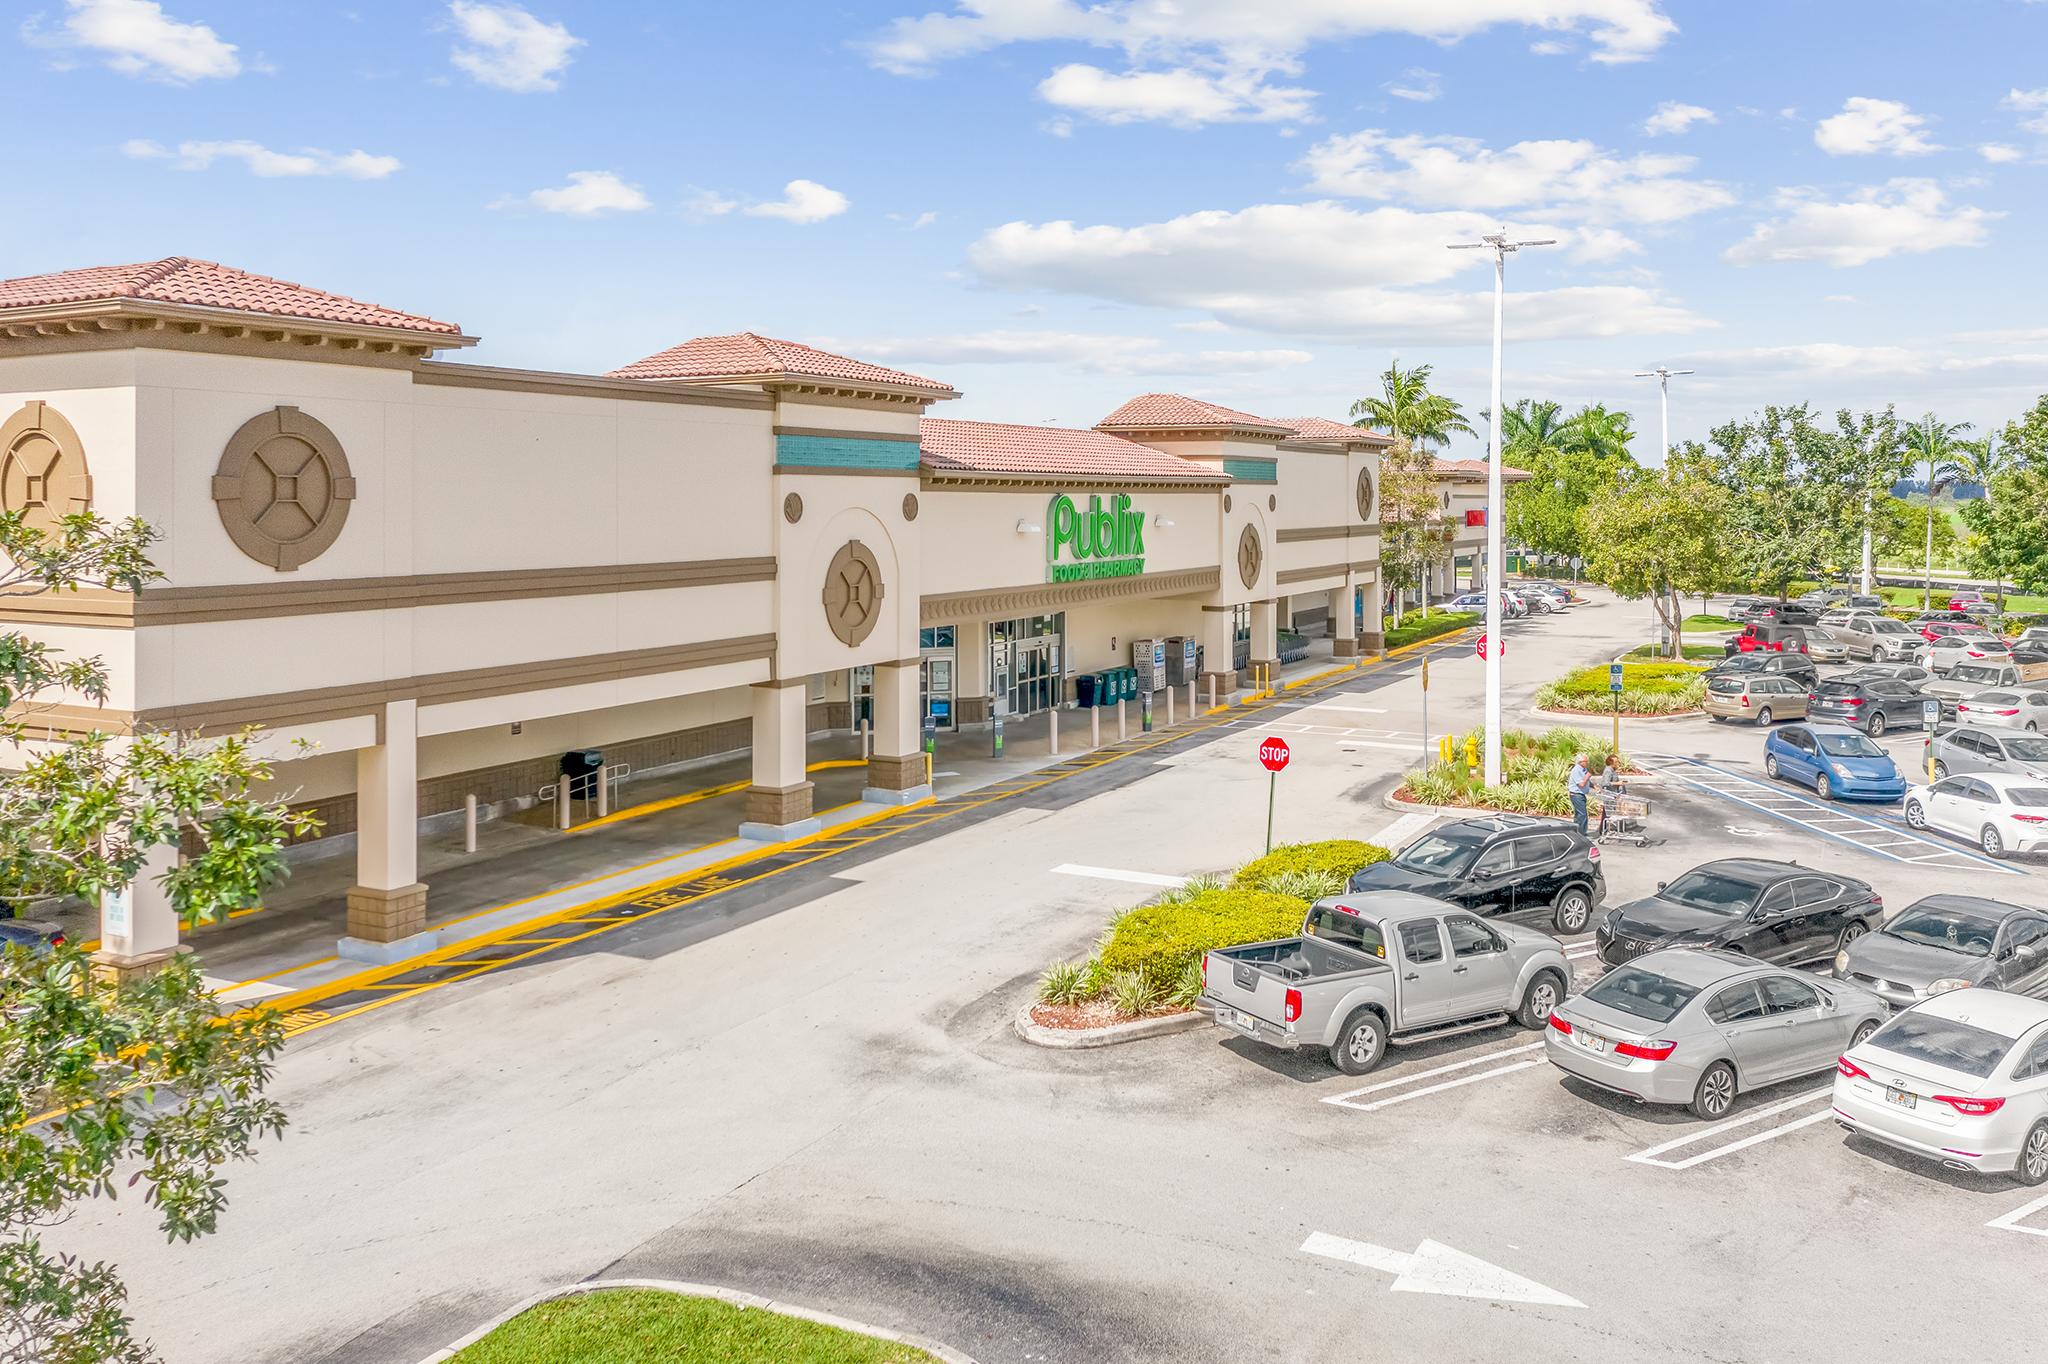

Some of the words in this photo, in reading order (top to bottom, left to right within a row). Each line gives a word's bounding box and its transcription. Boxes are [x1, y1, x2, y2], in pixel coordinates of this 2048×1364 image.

[1048, 494, 1146, 561] Publix
[1052, 564, 1082, 584] FOOD
[1093, 558, 1146, 579] PHARMACY
[1260, 746, 1289, 762] STOP
[630, 891, 693, 909] FIRE
[676, 875, 743, 894] LANE
